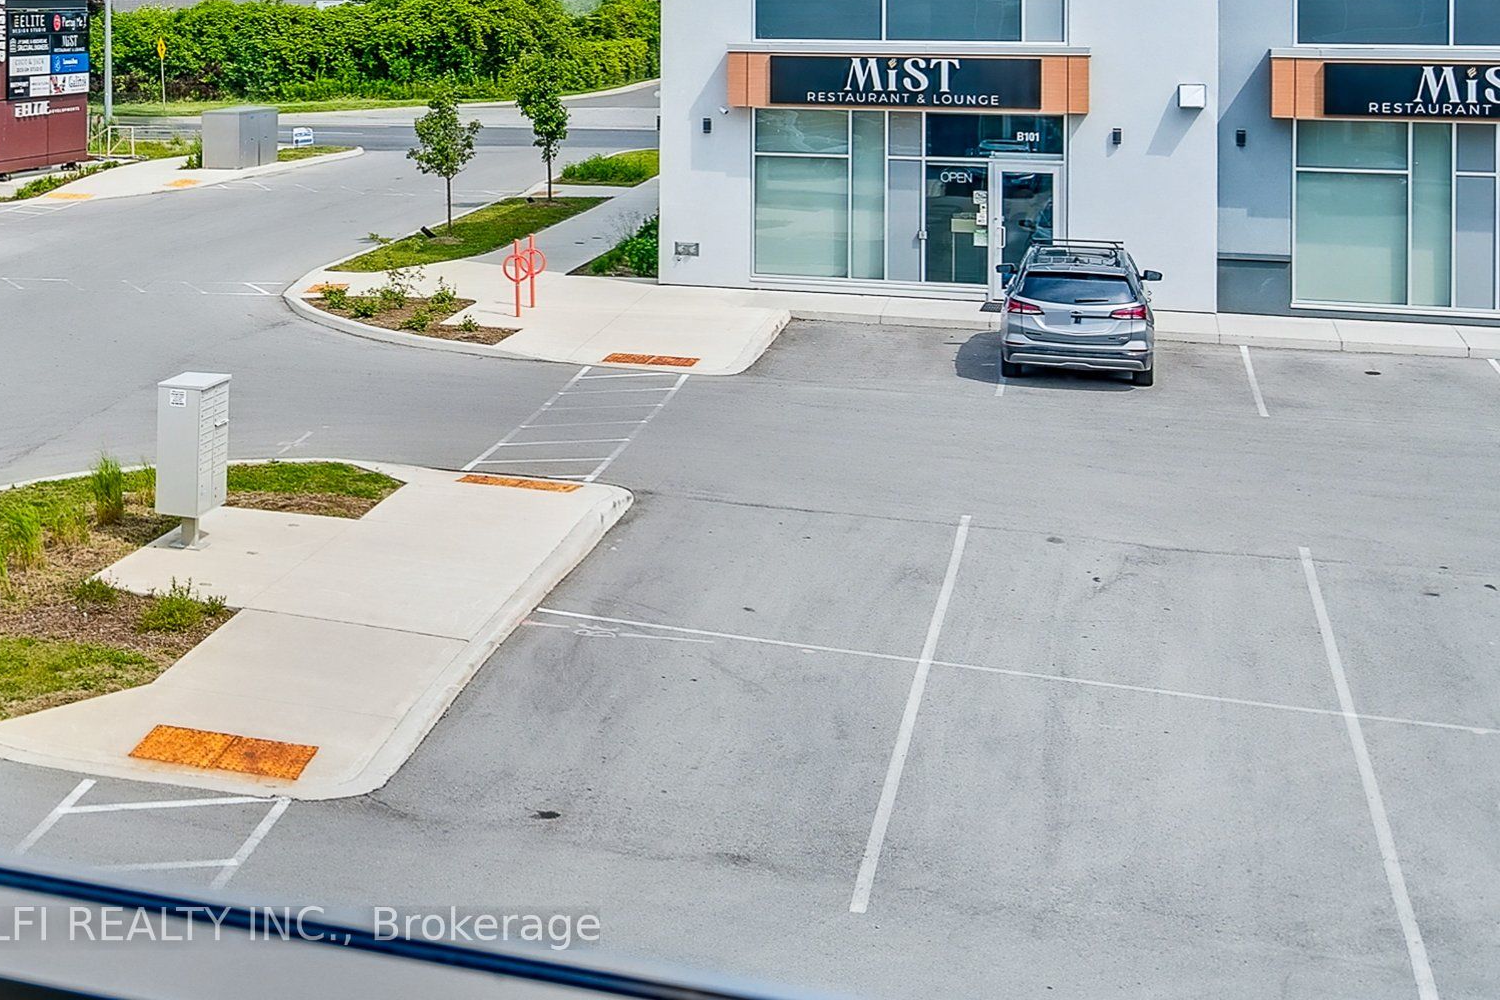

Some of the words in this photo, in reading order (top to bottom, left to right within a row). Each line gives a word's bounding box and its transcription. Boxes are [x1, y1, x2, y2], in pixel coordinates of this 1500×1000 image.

[20, 14, 45, 28] ELITE
[806, 90, 910, 104] RESTAURANT
[916, 94, 926, 104] &
[933, 94, 1000, 106] LOUNGE
[1368, 102, 1492, 116] RESTAURANT
[1016, 132, 1040, 142] B101
[940, 172, 973, 184] OPEN
